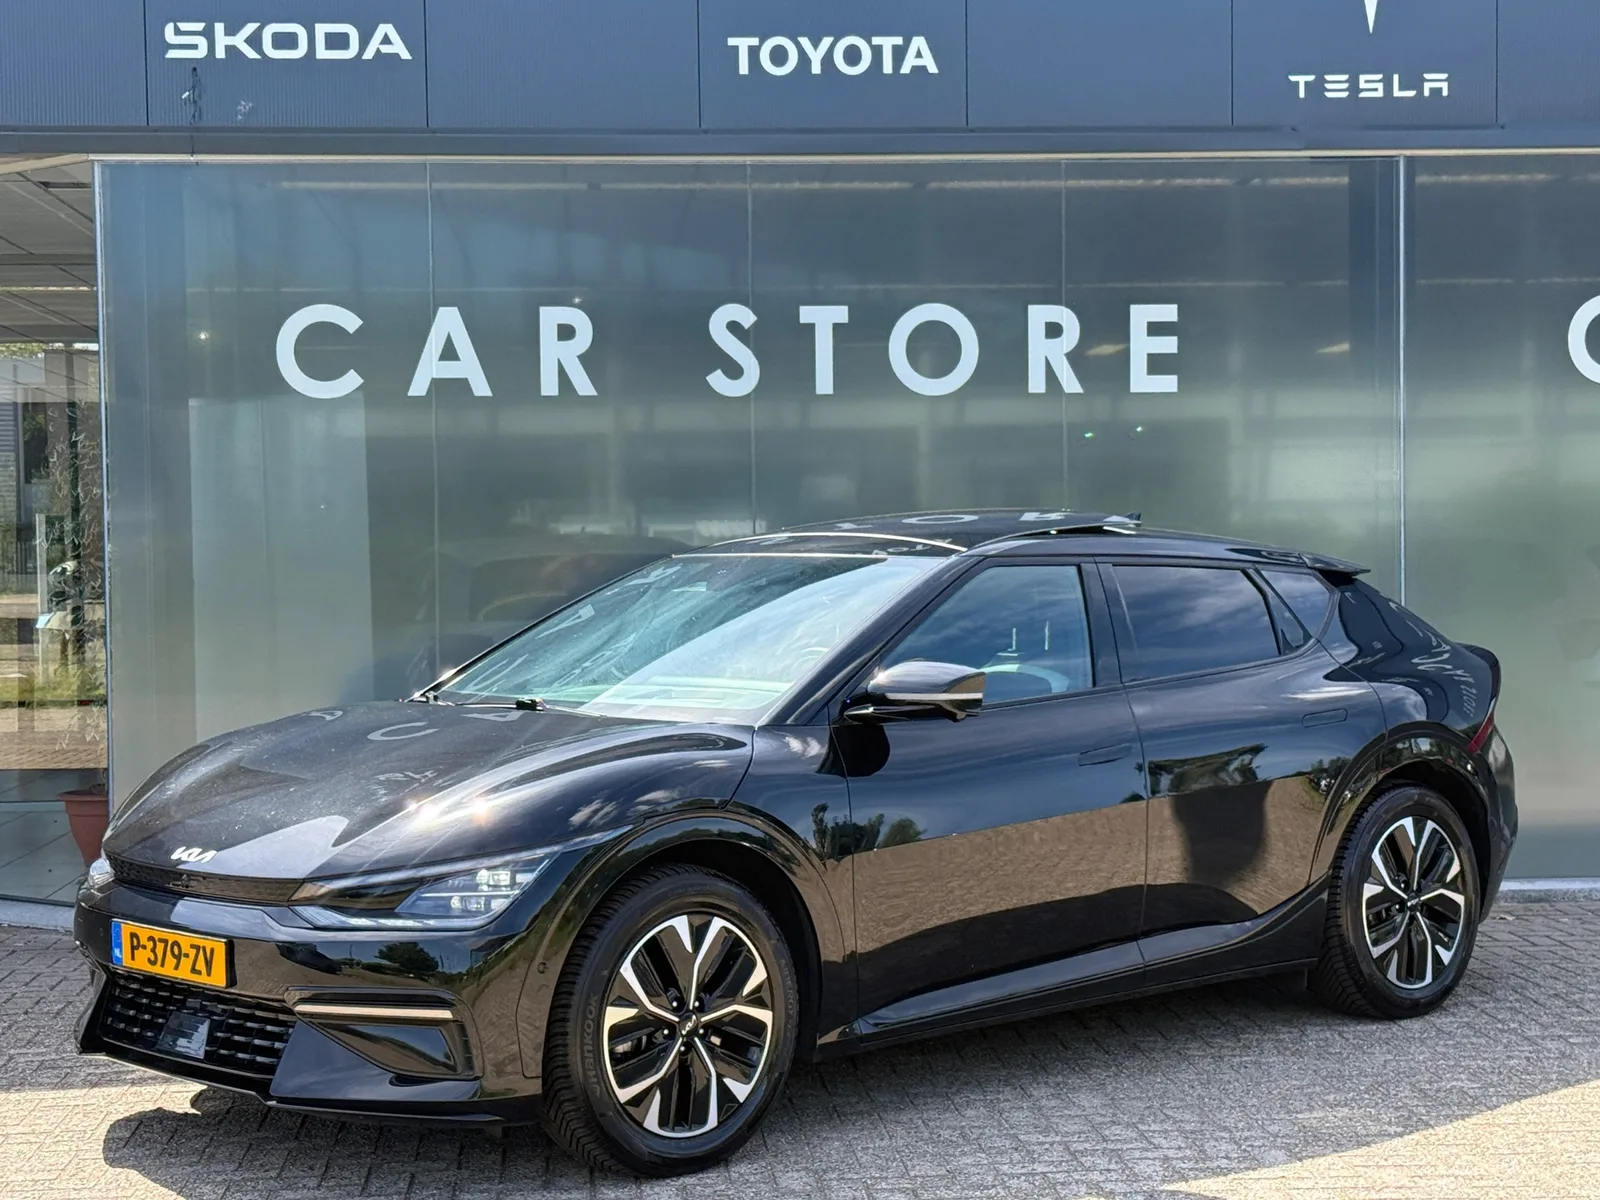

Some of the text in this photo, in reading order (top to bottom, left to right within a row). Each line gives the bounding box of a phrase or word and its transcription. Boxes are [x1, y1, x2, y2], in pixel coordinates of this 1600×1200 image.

[164, 22, 412, 60] SKODA
[728, 35, 938, 77] TOYOTA
[1288, 73, 1449, 99] TESLA
[275, 303, 1179, 399] CAR STORE
[129, 931, 215, 977] P-379-ZV
